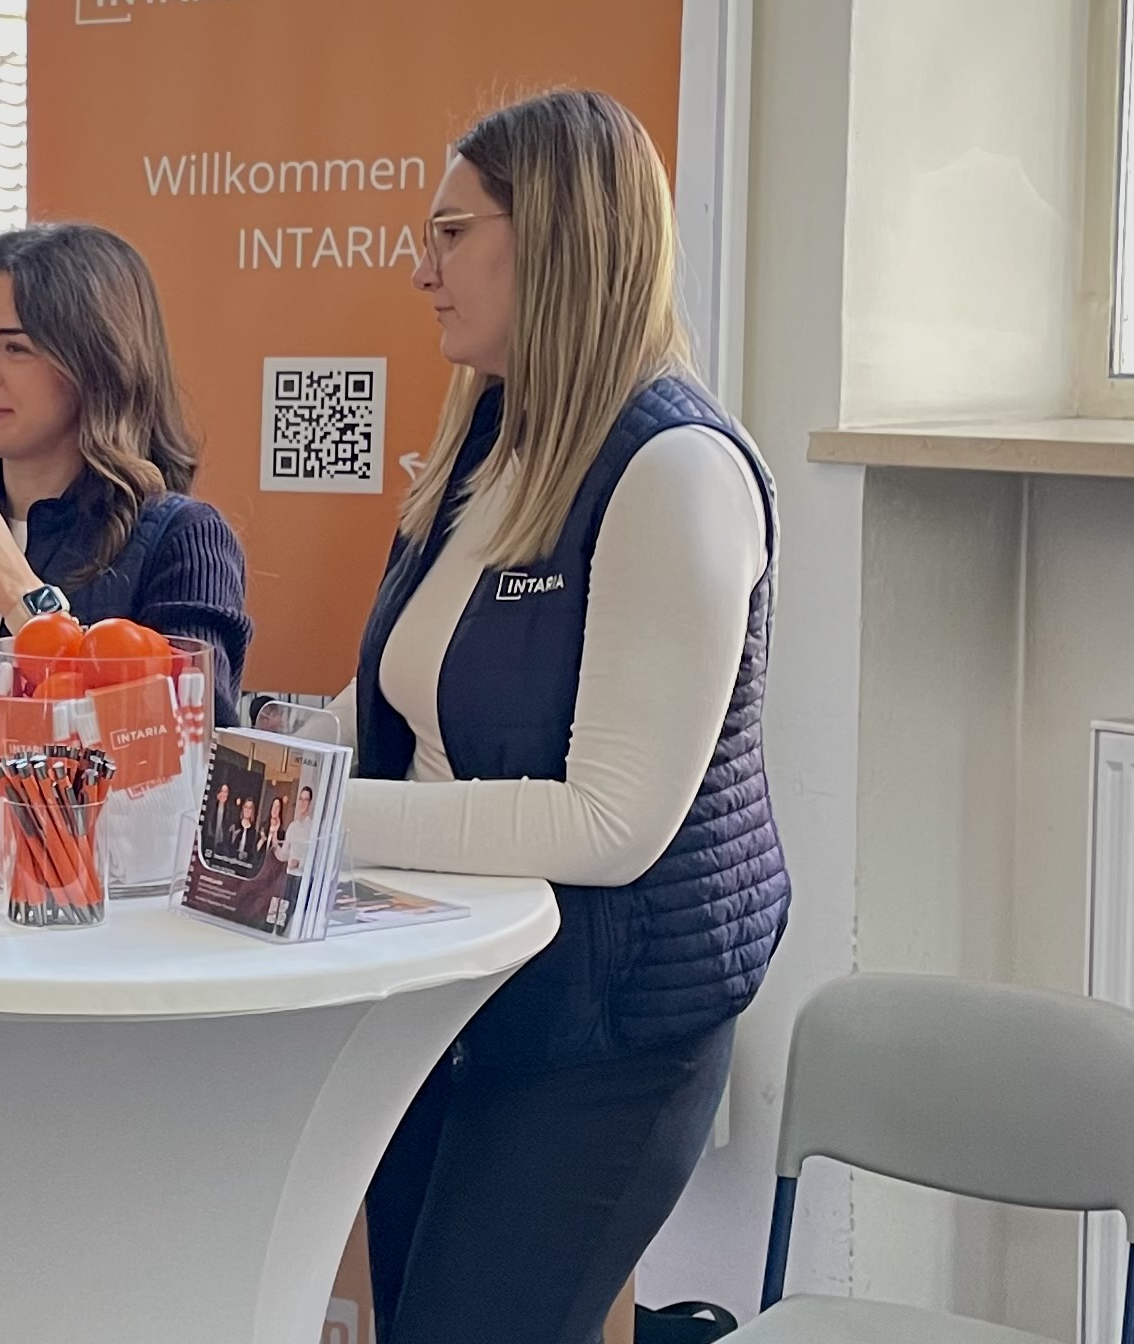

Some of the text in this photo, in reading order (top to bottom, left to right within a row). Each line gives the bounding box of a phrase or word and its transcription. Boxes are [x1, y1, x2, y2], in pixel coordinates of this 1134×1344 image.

[143, 151, 426, 197] Willkommen
[238, 224, 423, 270] INTARIA
[507, 573, 565, 594] INTARIA
[116, 724, 168, 745] INTARIA
